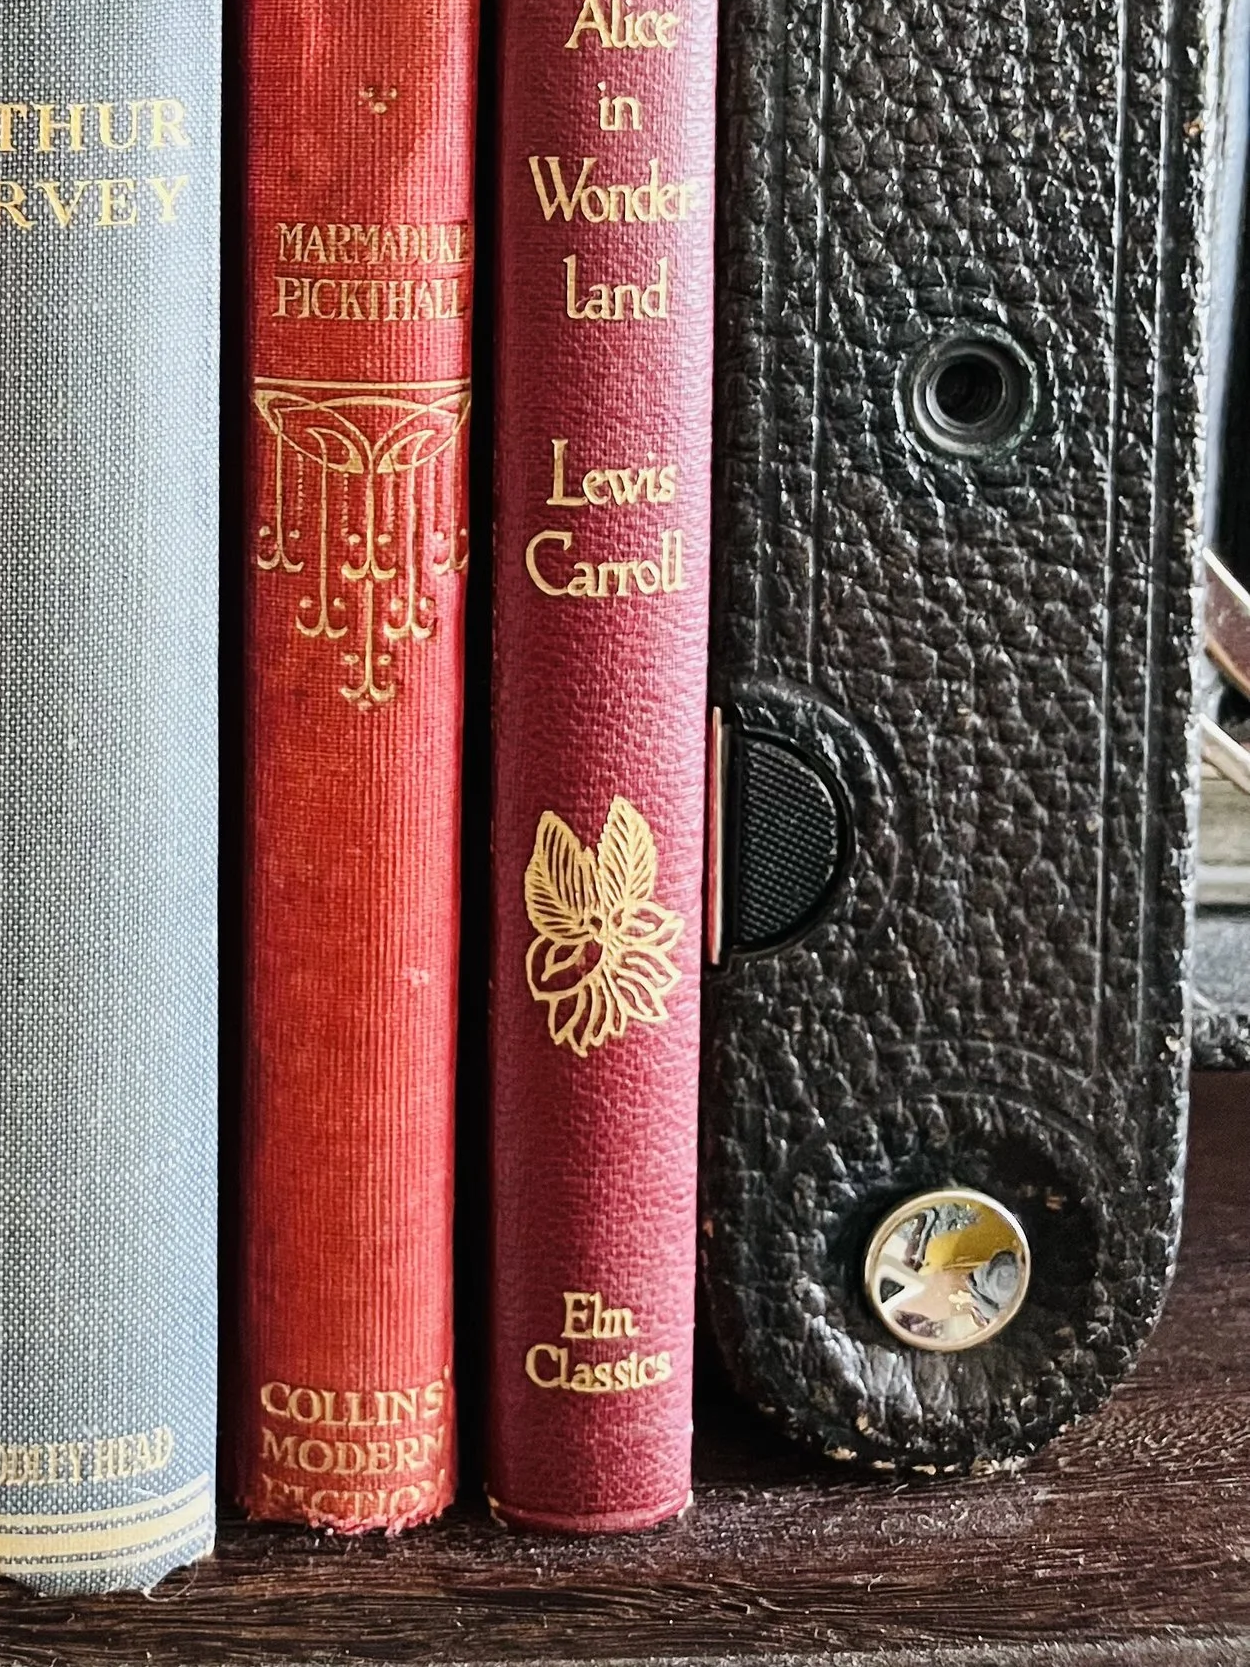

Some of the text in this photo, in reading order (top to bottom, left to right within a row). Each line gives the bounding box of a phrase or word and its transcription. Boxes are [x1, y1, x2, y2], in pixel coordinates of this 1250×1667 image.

[597, 81, 643, 132] in
[271, 276, 465, 321] PICKTHALL
[546, 438, 679, 506] Lewis
[525, 529, 690, 598] Carroll
[561, 1290, 640, 1340] Elm
[525, 1343, 672, 1394] Classics
[93, 1425, 177, 1482] HEAD
[260, 1425, 447, 1476] MODERN
